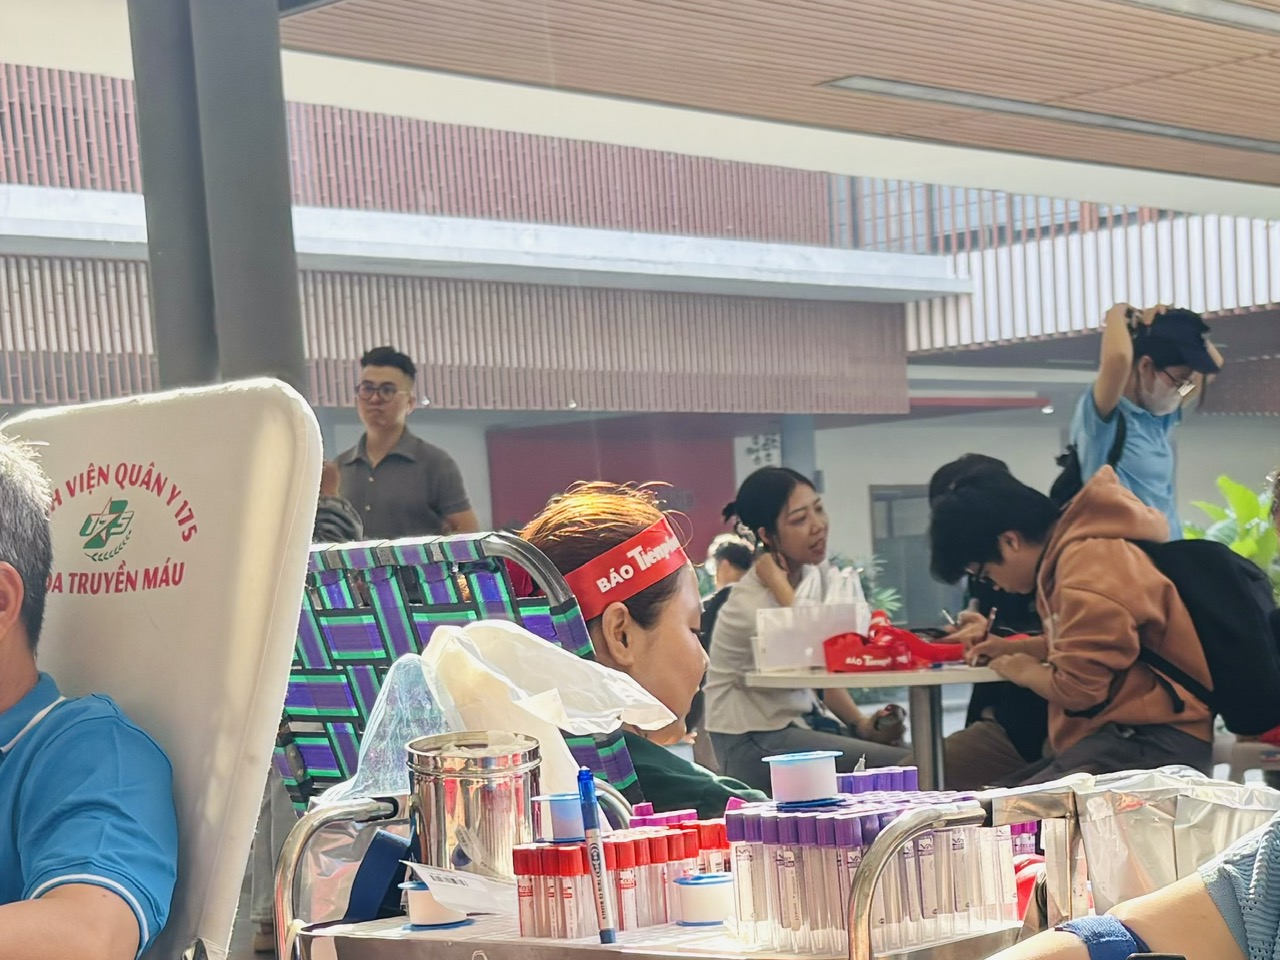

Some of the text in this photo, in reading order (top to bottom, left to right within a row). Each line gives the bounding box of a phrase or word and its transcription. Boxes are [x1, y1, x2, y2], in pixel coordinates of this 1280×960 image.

[65, 461, 199, 543] VIỆN QUÂN Y 175
[68, 559, 139, 596] TRUYỀN
[141, 556, 186, 590] MÁU
[595, 567, 635, 594] BÁO
